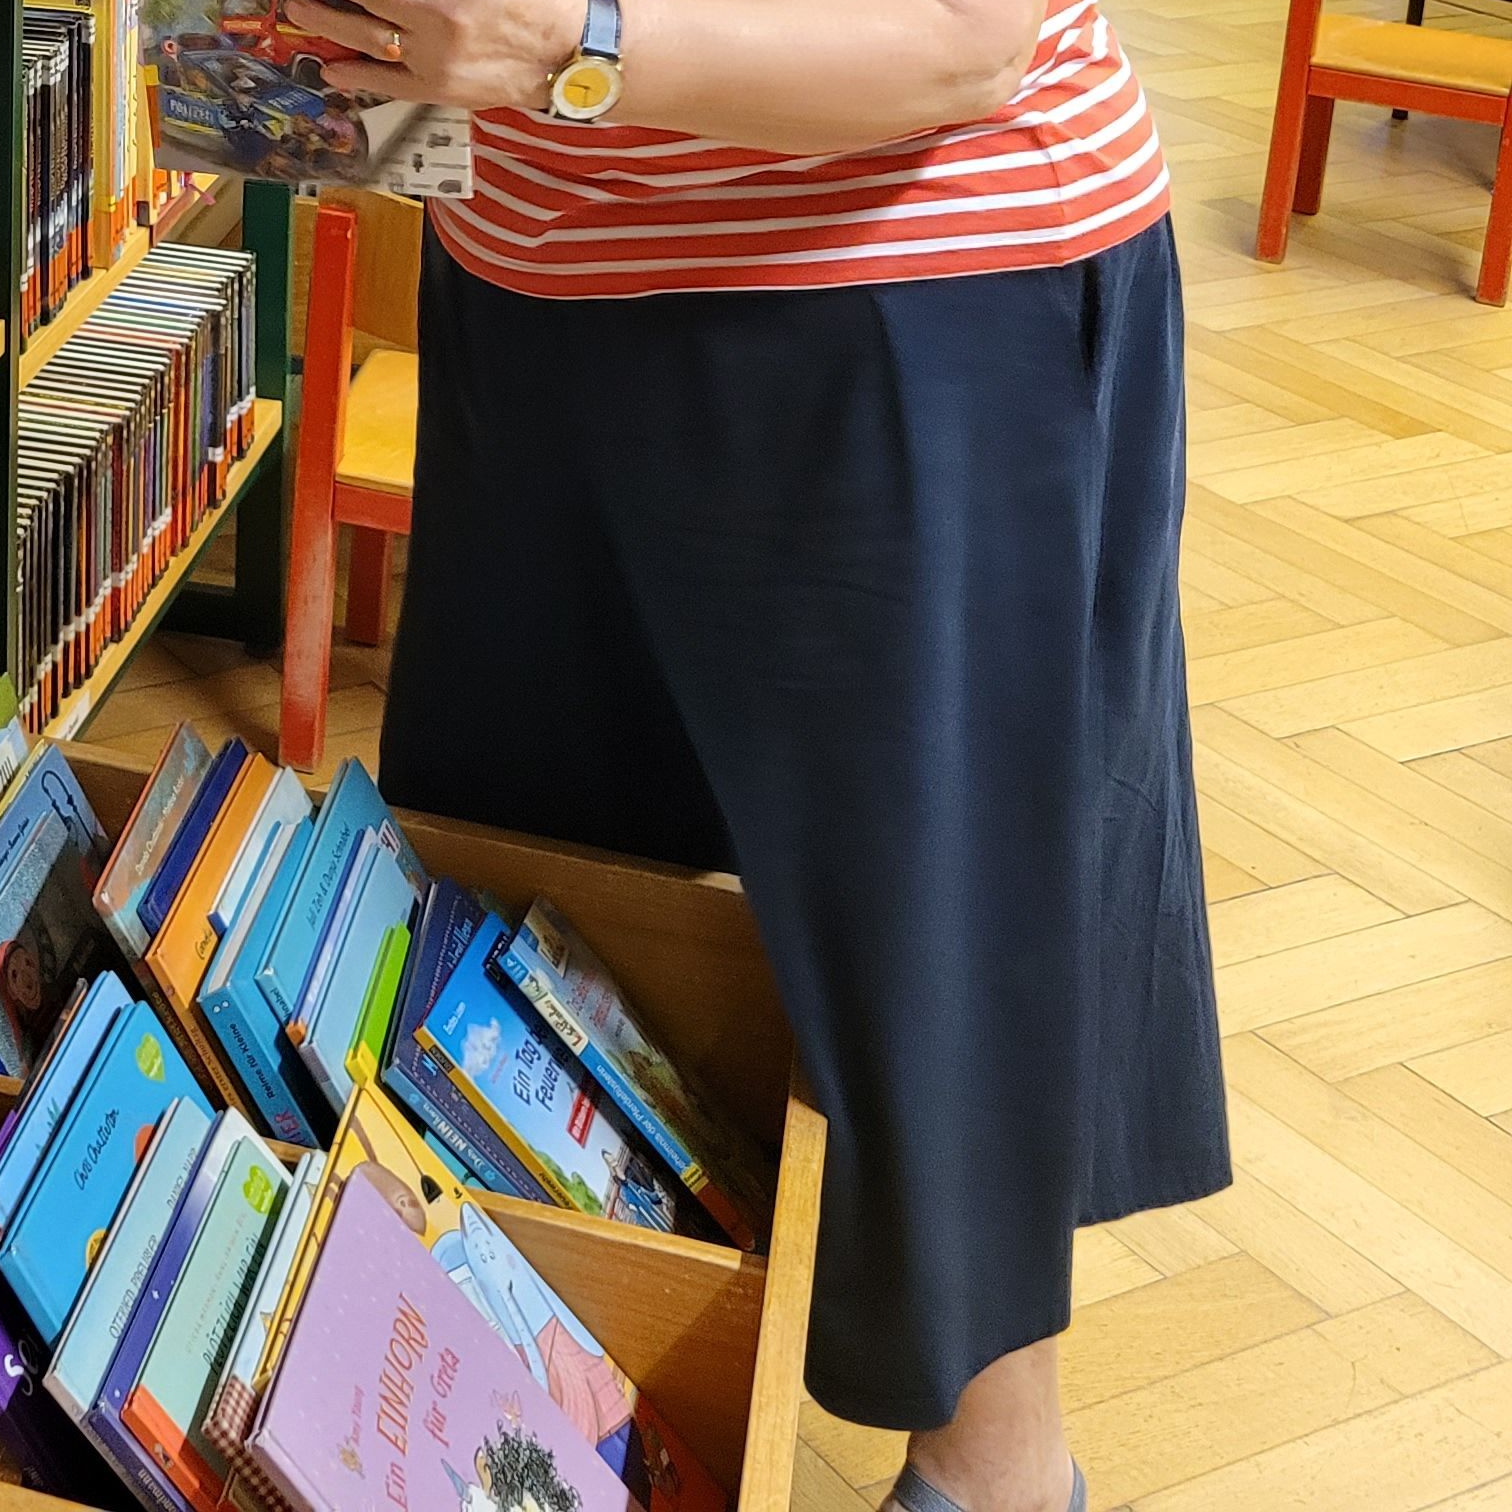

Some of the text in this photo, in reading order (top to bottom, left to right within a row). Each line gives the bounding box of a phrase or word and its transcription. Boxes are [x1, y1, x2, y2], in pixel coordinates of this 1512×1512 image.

[513, 1040, 541, 1105] Ein Tag
[377, 1292, 429, 1458] EINHORN
[423, 1347, 460, 1448] für Greta
